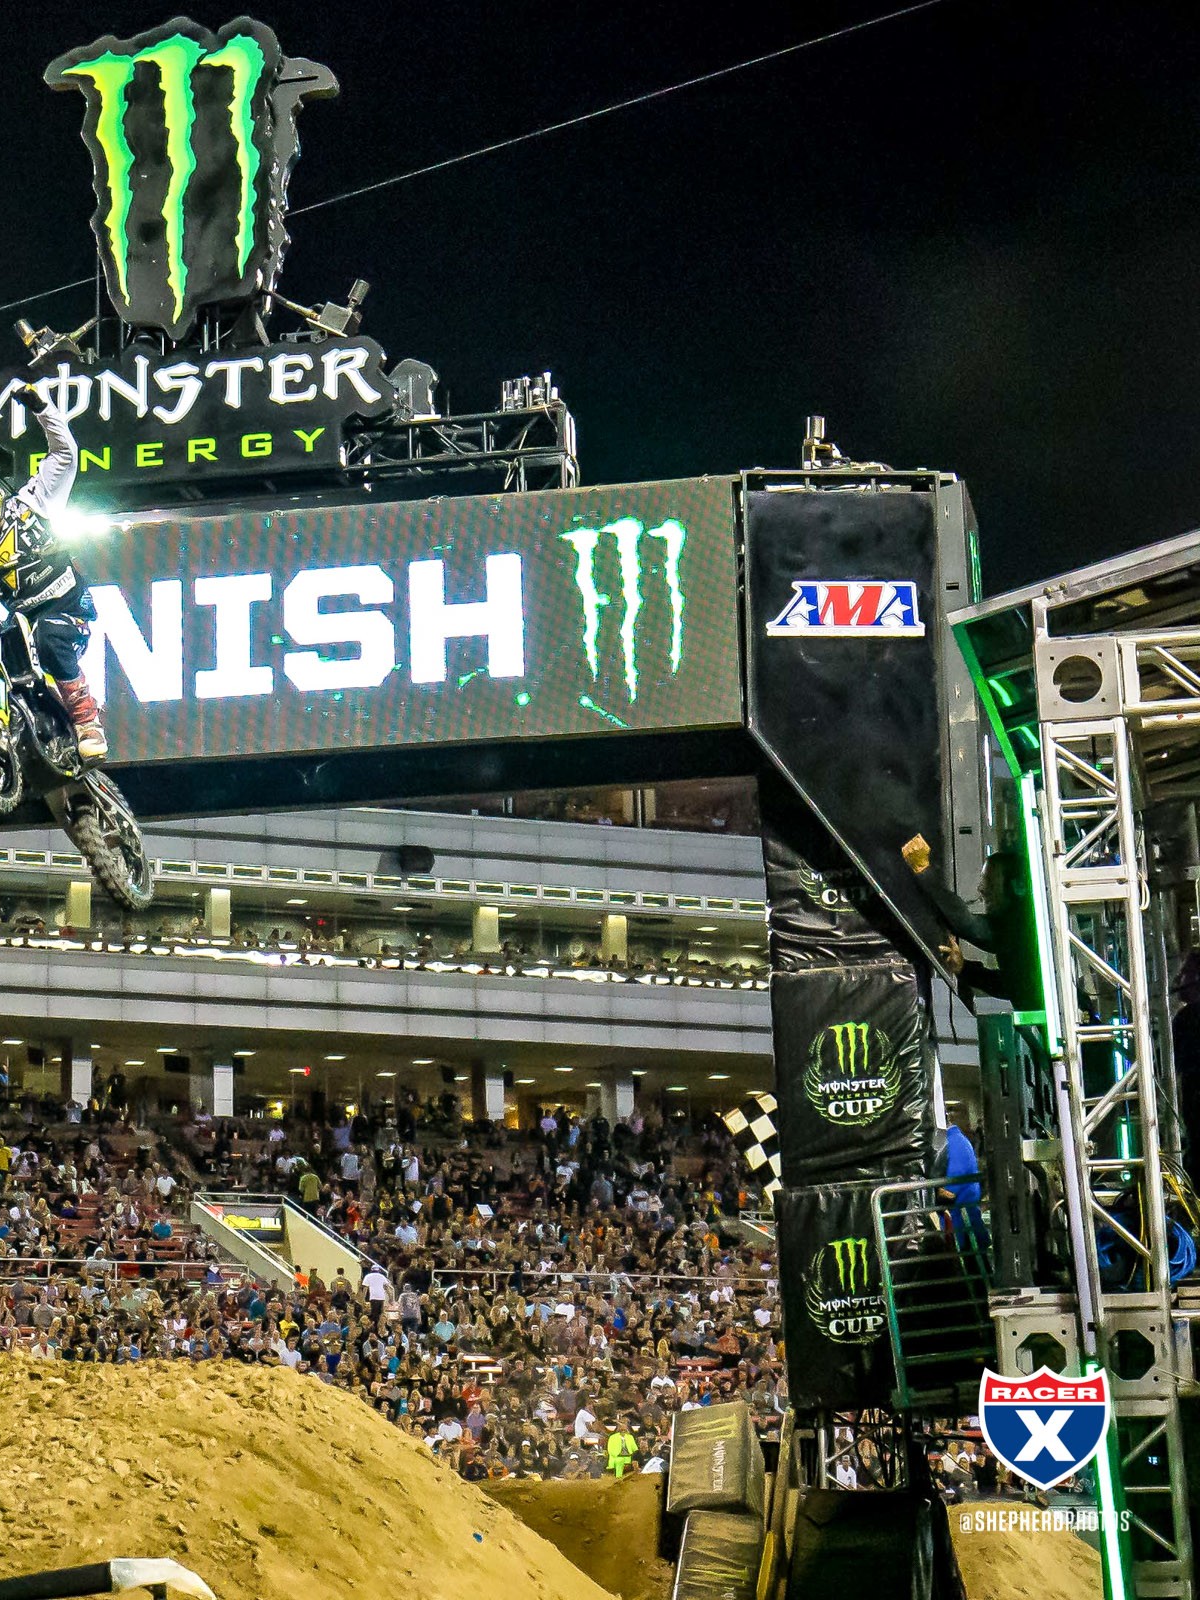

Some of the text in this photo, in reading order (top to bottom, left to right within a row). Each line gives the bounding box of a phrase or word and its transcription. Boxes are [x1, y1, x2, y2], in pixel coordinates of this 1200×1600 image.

[773, 583, 921, 629] AMA
[818, 1078, 888, 1094] MONSTER
[827, 1098, 883, 1118] CUP
[819, 1295, 887, 1312] MONSTER
[828, 1316, 884, 1336] CUP
